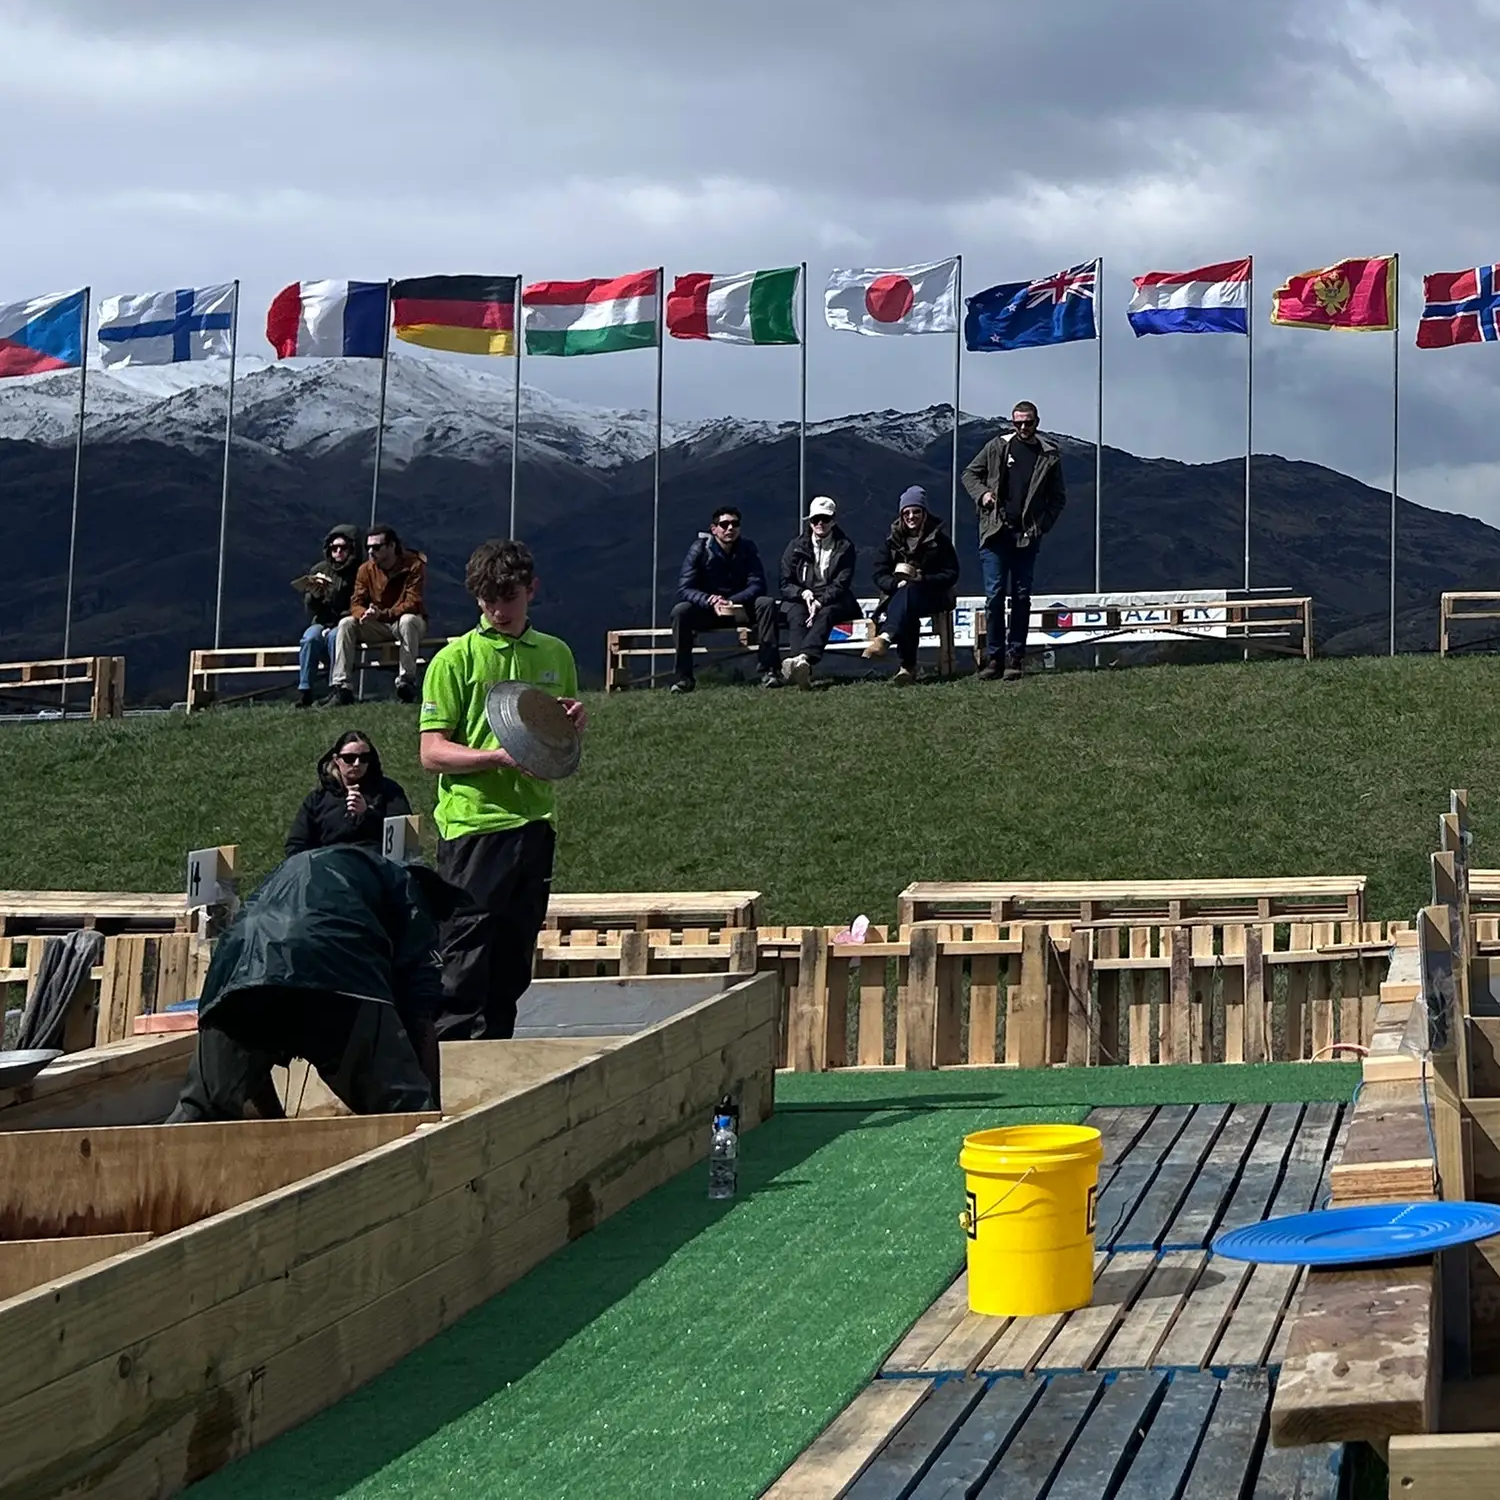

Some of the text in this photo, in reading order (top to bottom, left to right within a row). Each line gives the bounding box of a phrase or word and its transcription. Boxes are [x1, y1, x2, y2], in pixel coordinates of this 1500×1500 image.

[1085, 601, 1210, 623] BAZIR
[385, 824, 395, 855] 13
[190, 860, 202, 897] 14
